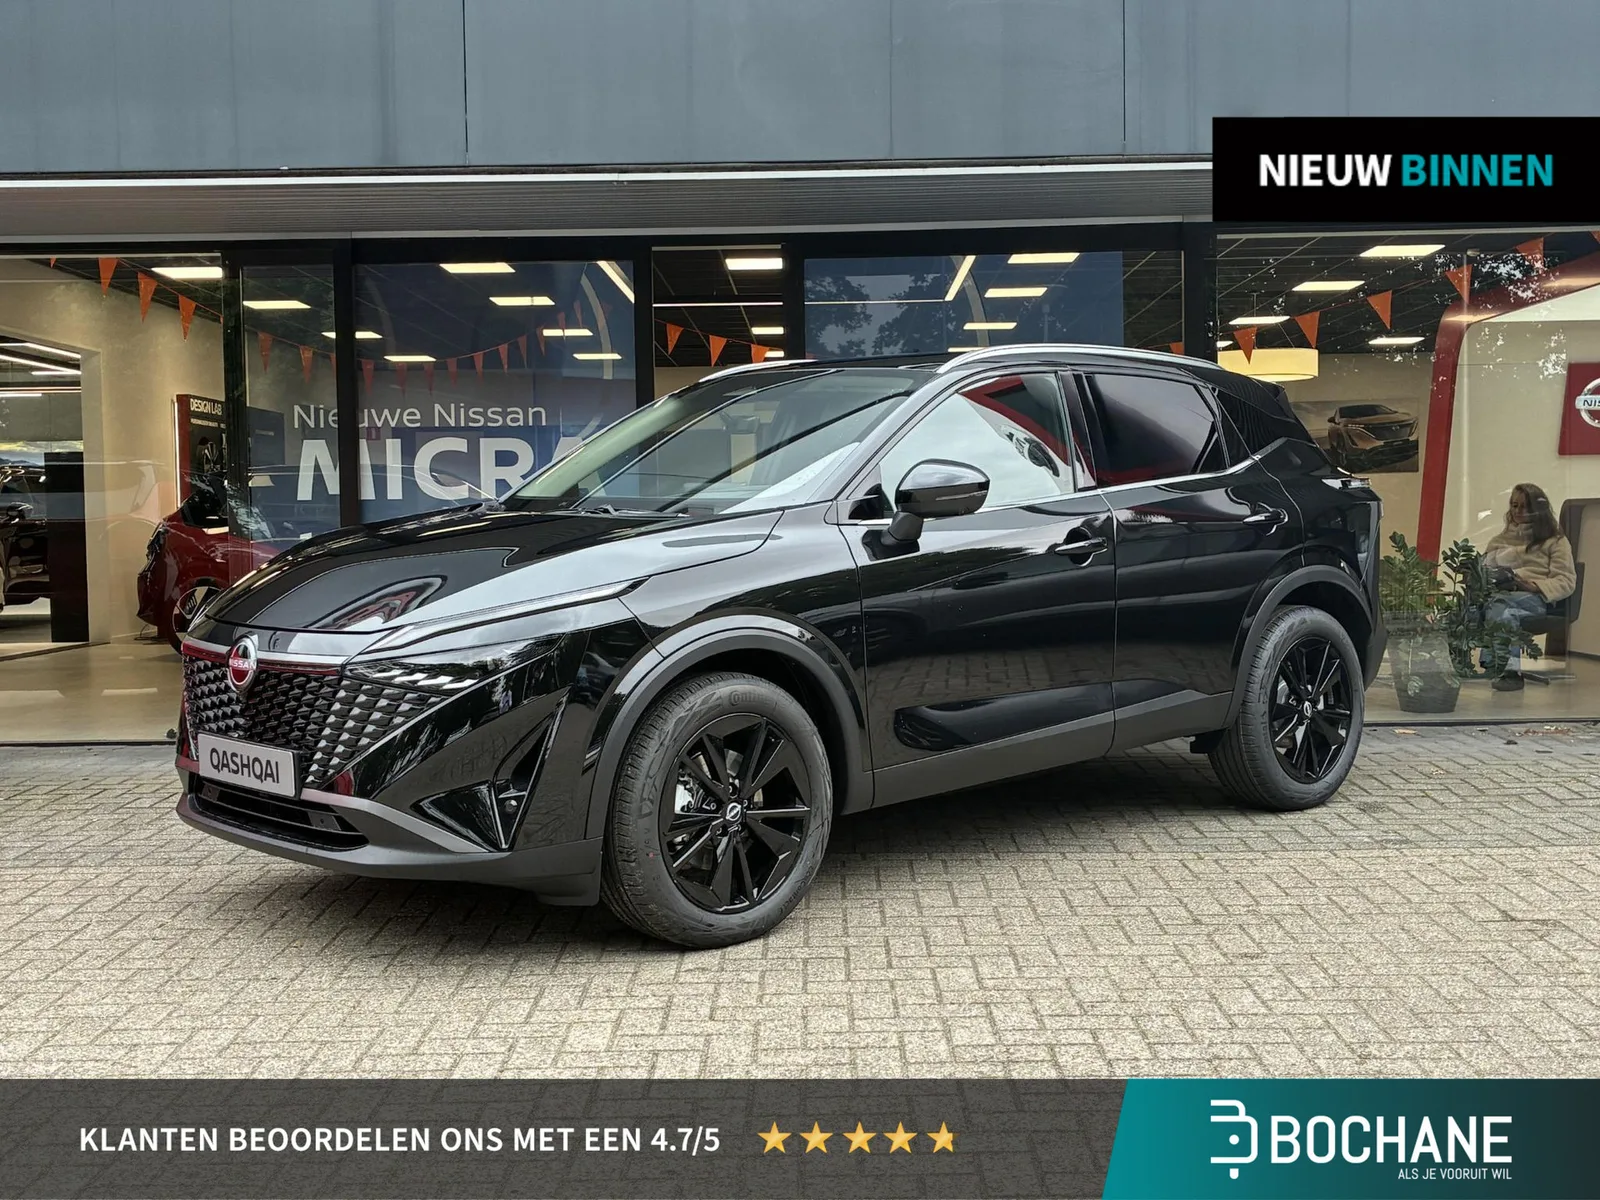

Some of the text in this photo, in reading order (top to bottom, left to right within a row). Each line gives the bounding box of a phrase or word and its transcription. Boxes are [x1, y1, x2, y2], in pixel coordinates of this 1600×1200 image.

[190, 398, 222, 416] DESIGN LAB
[294, 404, 546, 428] Nieuwe Nissan
[229, 659, 256, 670] SSAN
[210, 747, 280, 783] QASHQAI
